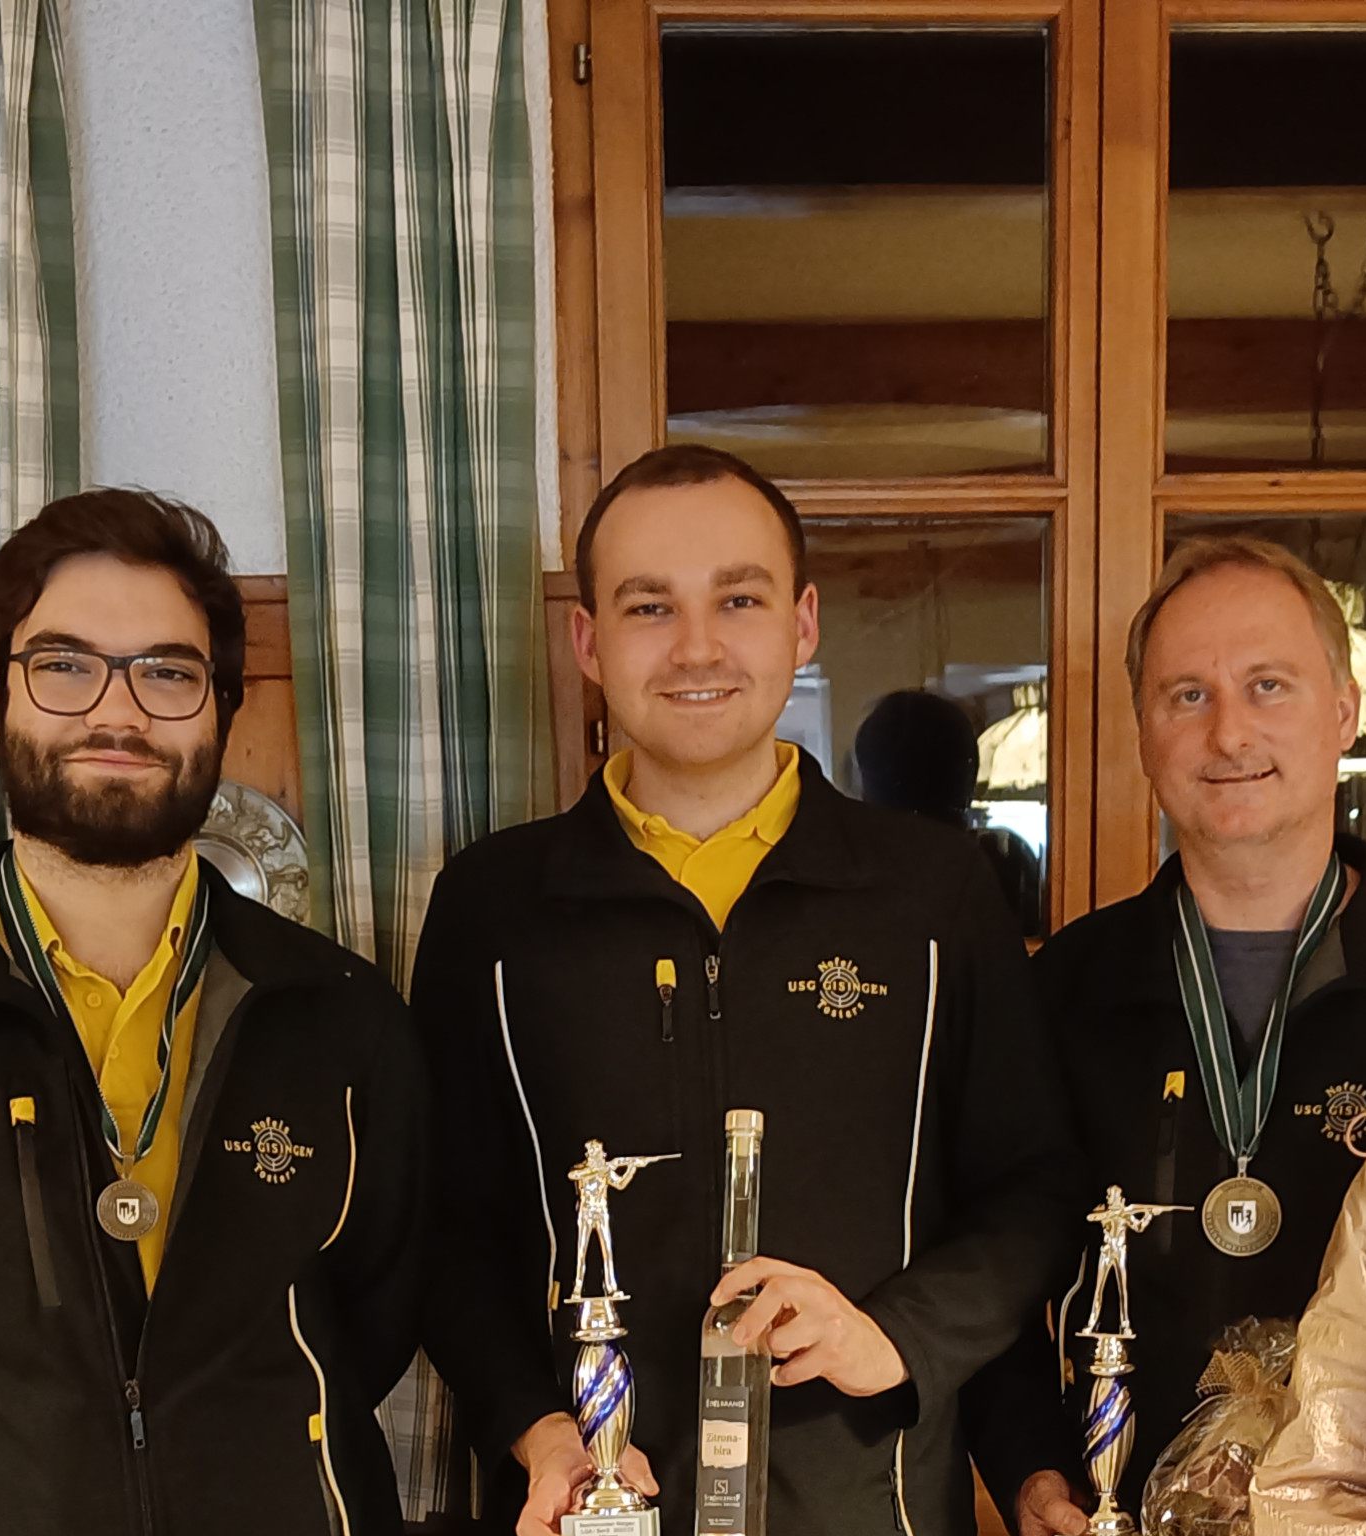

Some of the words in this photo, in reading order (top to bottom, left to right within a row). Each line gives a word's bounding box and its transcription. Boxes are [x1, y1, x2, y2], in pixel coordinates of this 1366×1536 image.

[788, 980, 816, 992] USG
[823, 981, 888, 996] GISINGEN
[1294, 1104, 1323, 1115] USG
[224, 1139, 252, 1152] USG
[258, 1142, 314, 1158] GISINGEN
